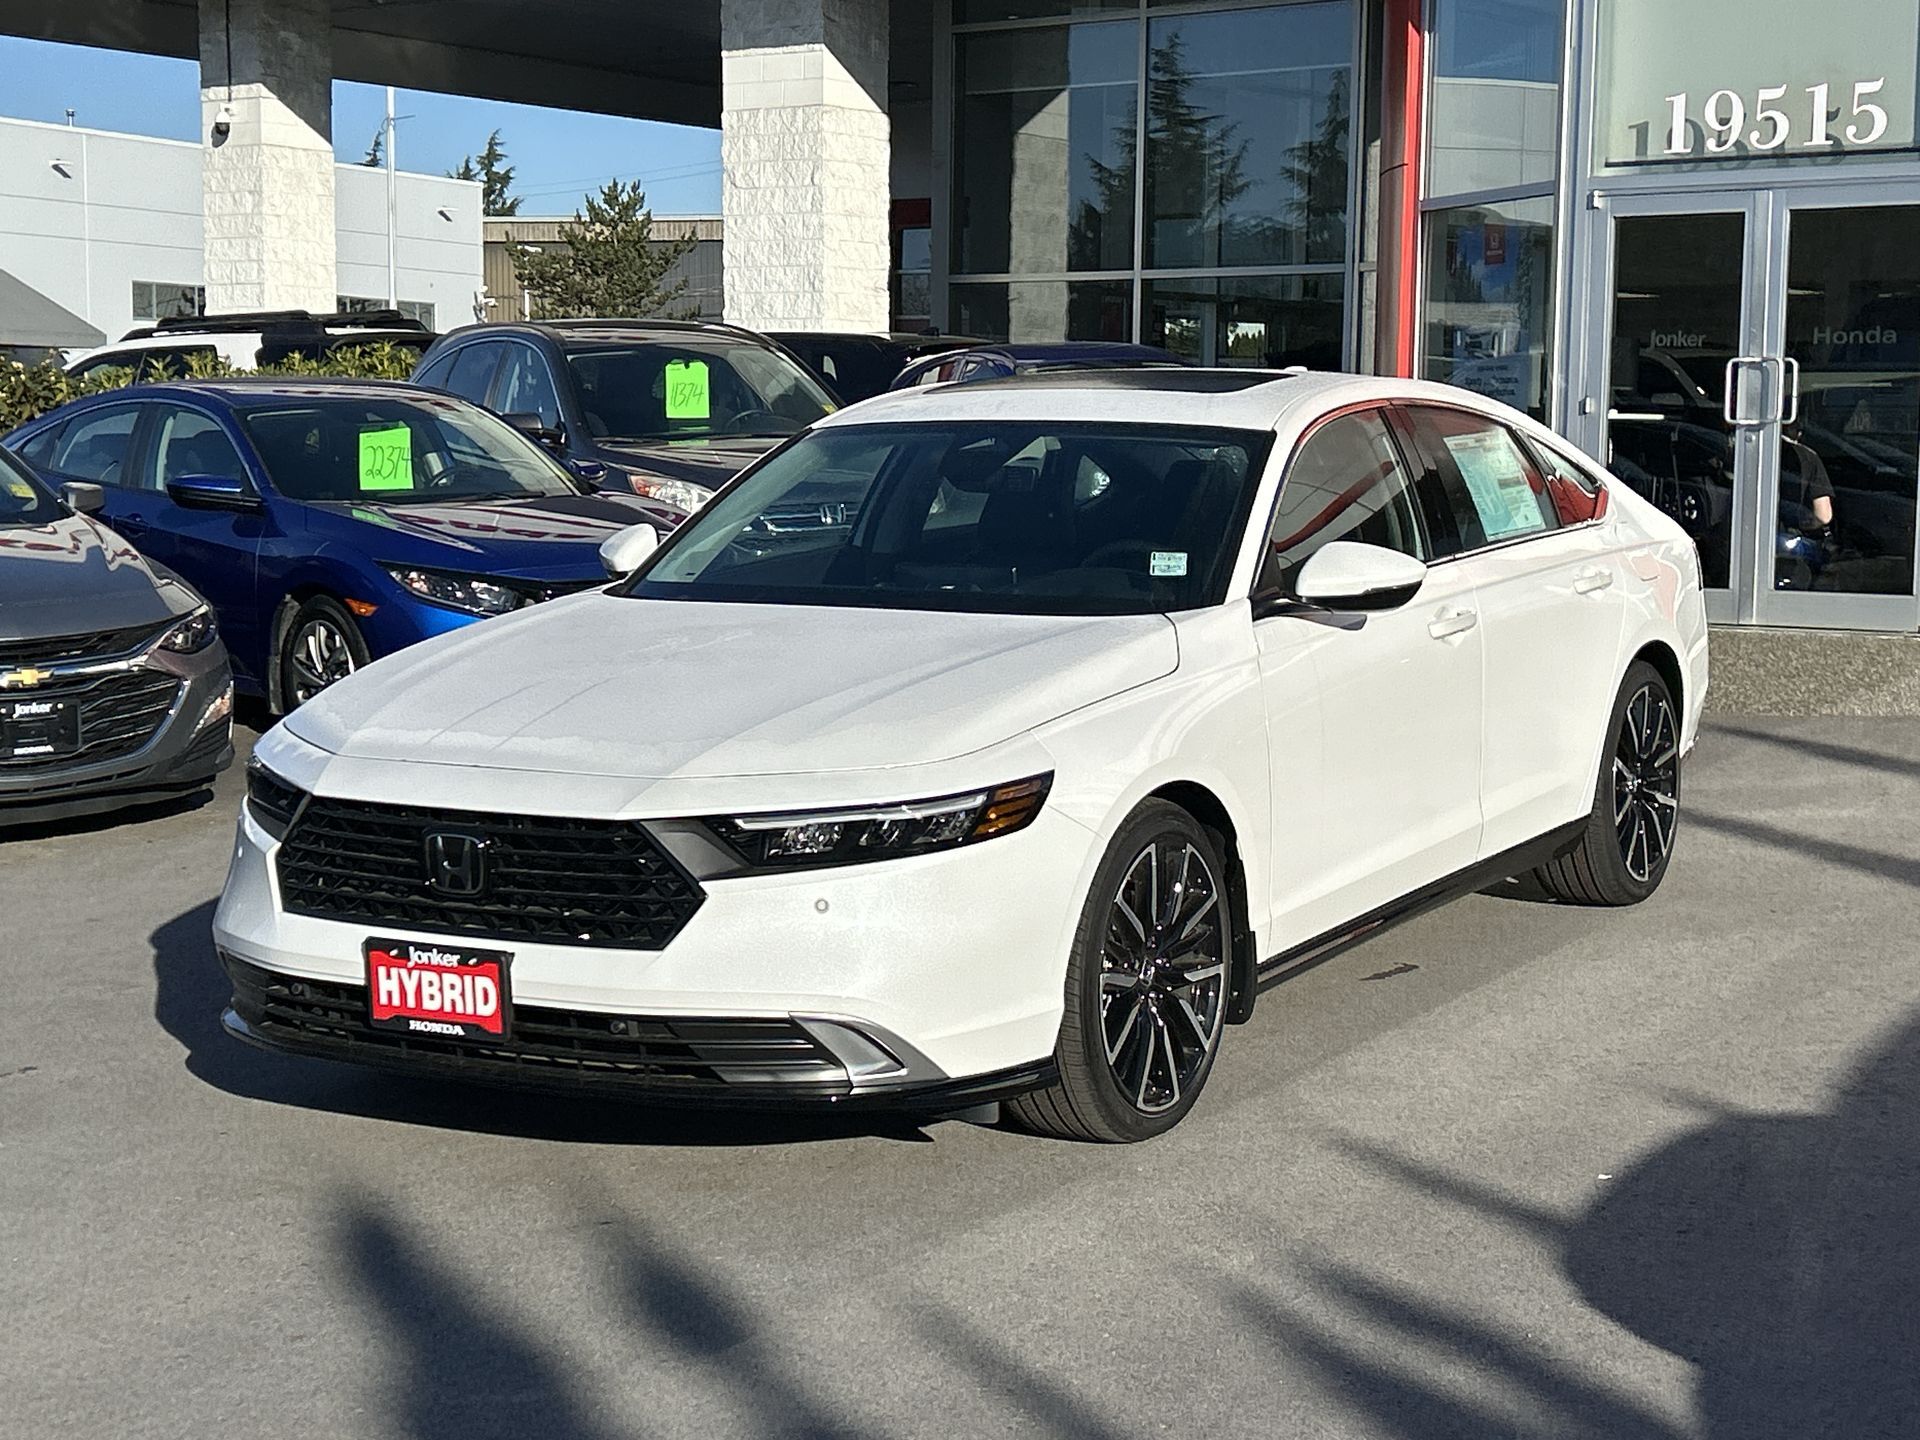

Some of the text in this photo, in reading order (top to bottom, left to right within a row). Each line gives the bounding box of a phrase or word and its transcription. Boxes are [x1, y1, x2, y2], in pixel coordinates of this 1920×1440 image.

[1664, 77, 1889, 154] 19515
[1650, 325, 1897, 350] Jonker Honda
[365, 445, 411, 480] 22374
[407, 946, 460, 967] Jonker
[378, 966, 497, 1017] HYBRID
[408, 1020, 465, 1036] HONDA
